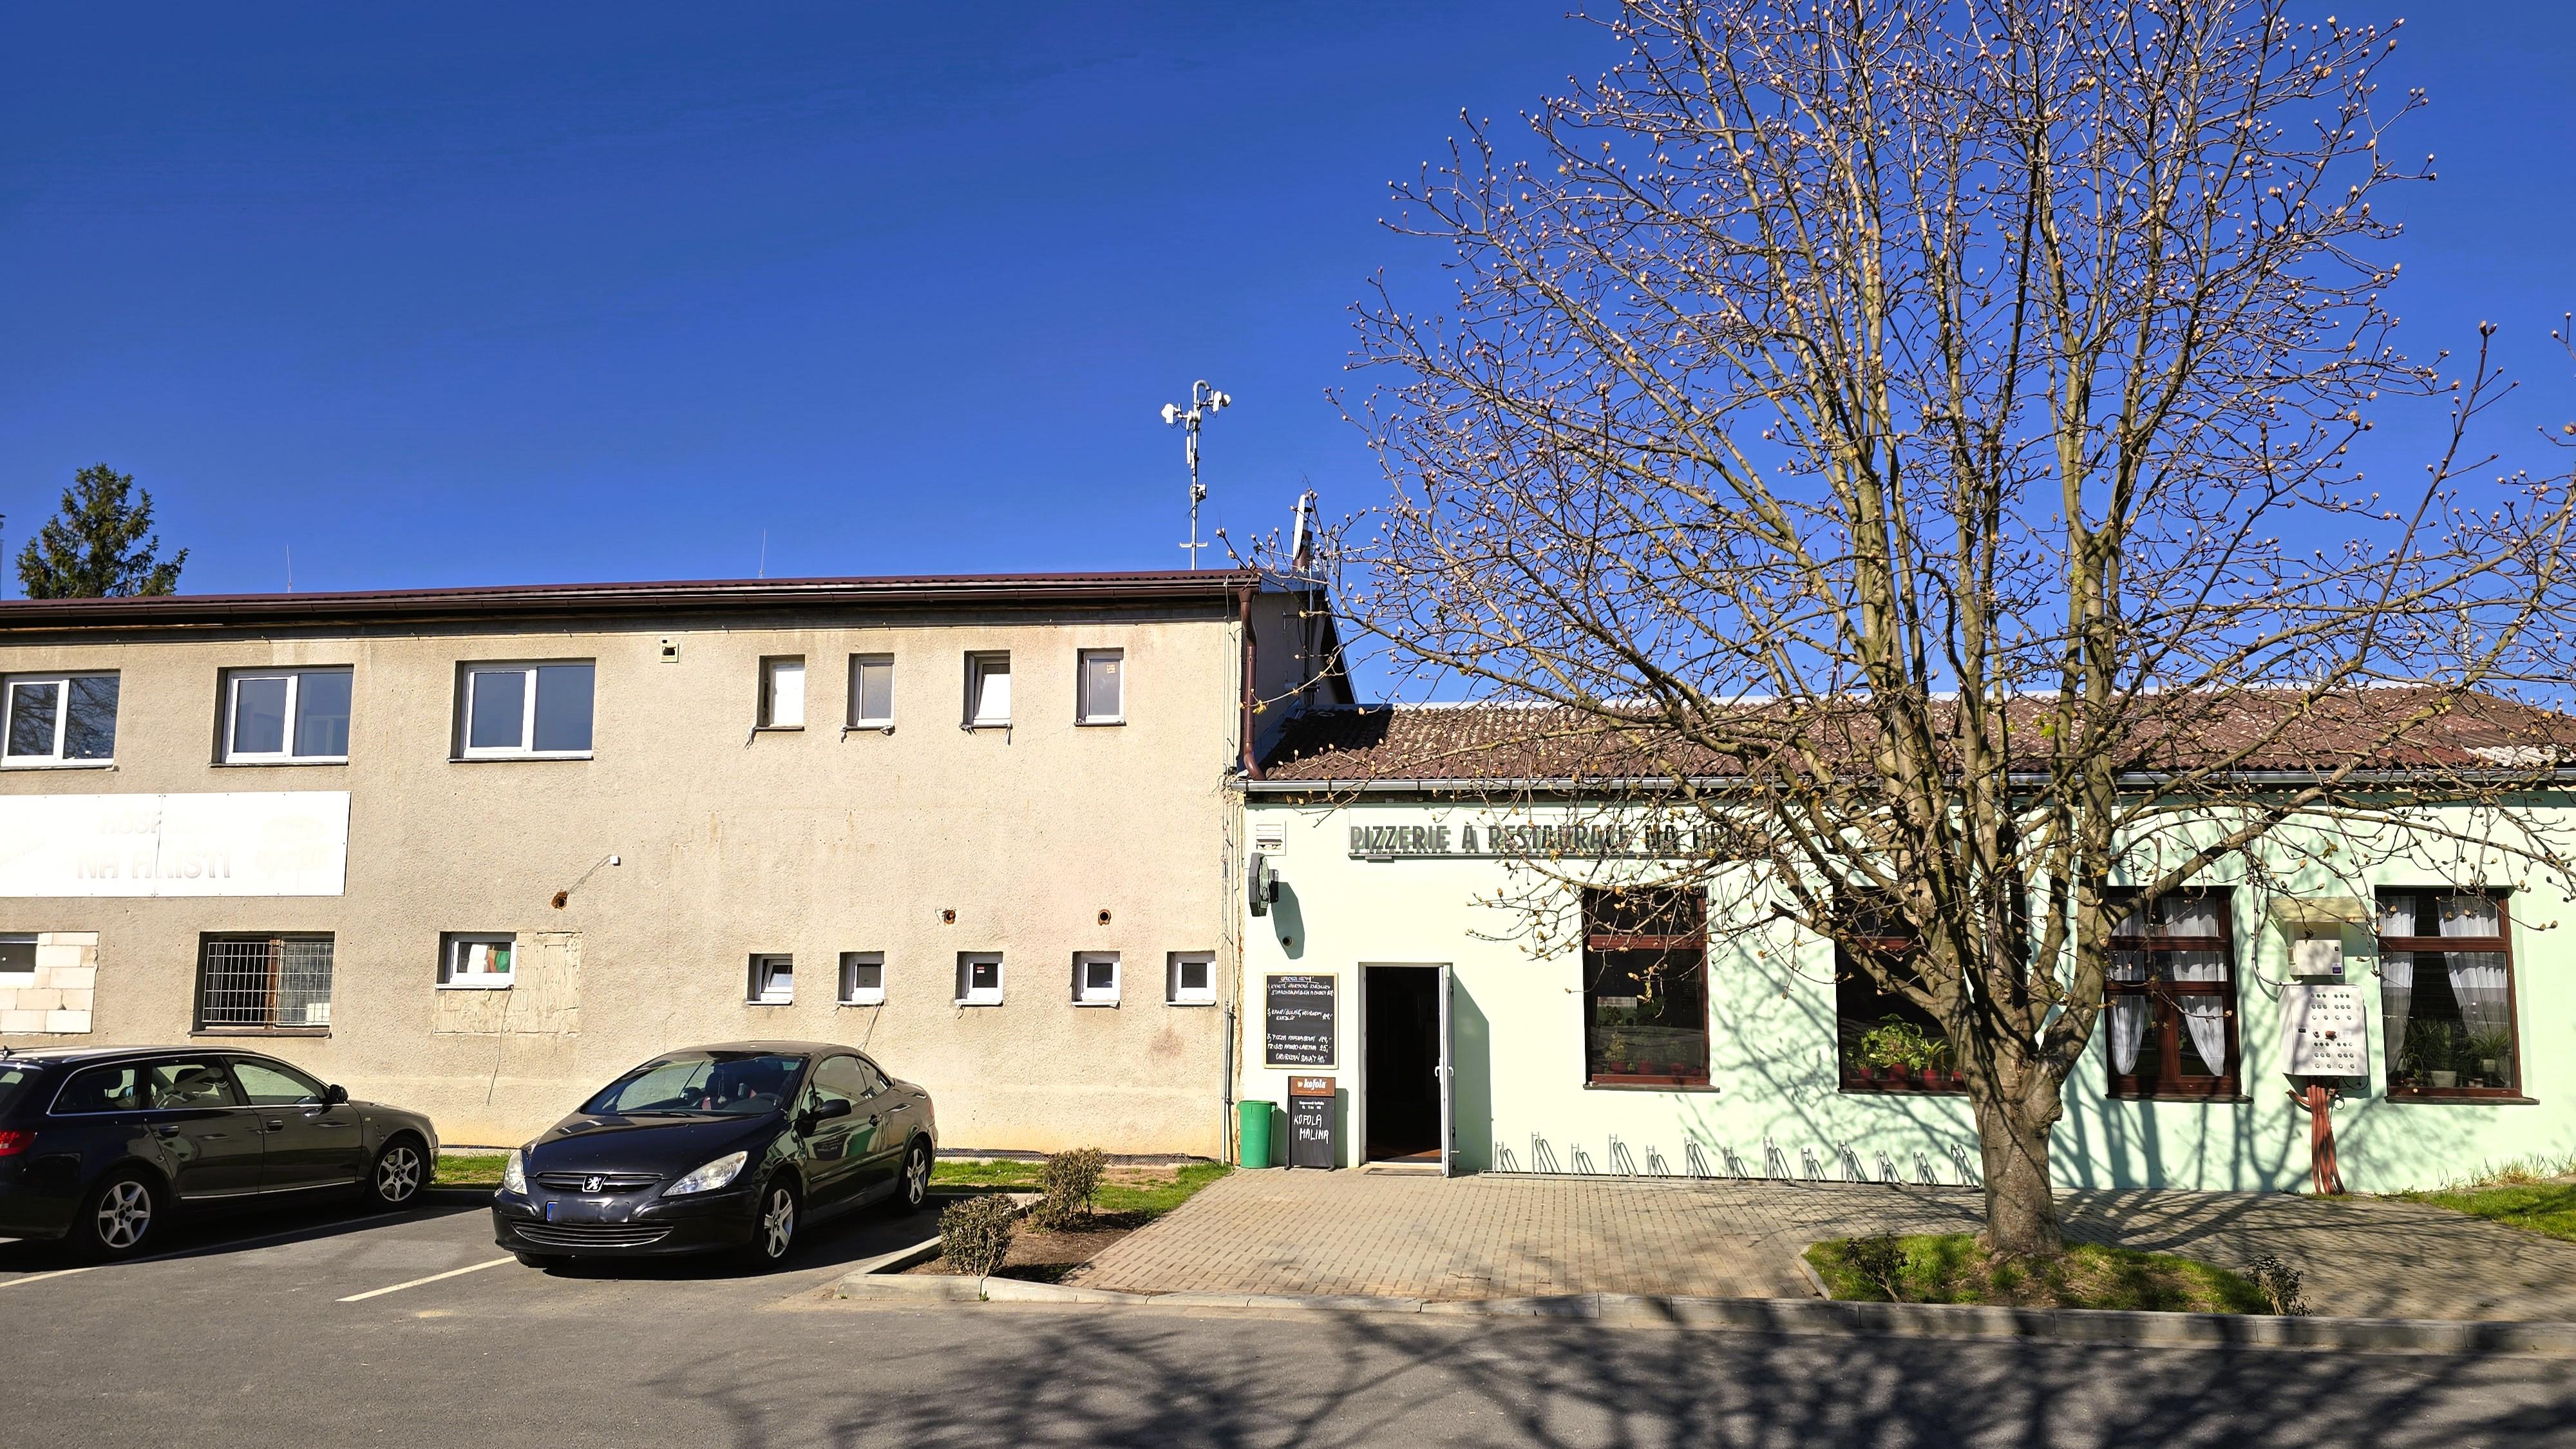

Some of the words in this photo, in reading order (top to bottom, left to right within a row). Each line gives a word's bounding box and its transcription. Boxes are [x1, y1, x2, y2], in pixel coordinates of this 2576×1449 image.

[1349, 825, 1446, 849] PIZZERIE
[1460, 825, 1475, 849] A
[1487, 824, 1630, 849] RESTAURACE
[1303, 1078, 1327, 1091] kofola
[1294, 1114, 1322, 1128] KOFOLA
[1299, 1128, 1329, 1144] MALINA
